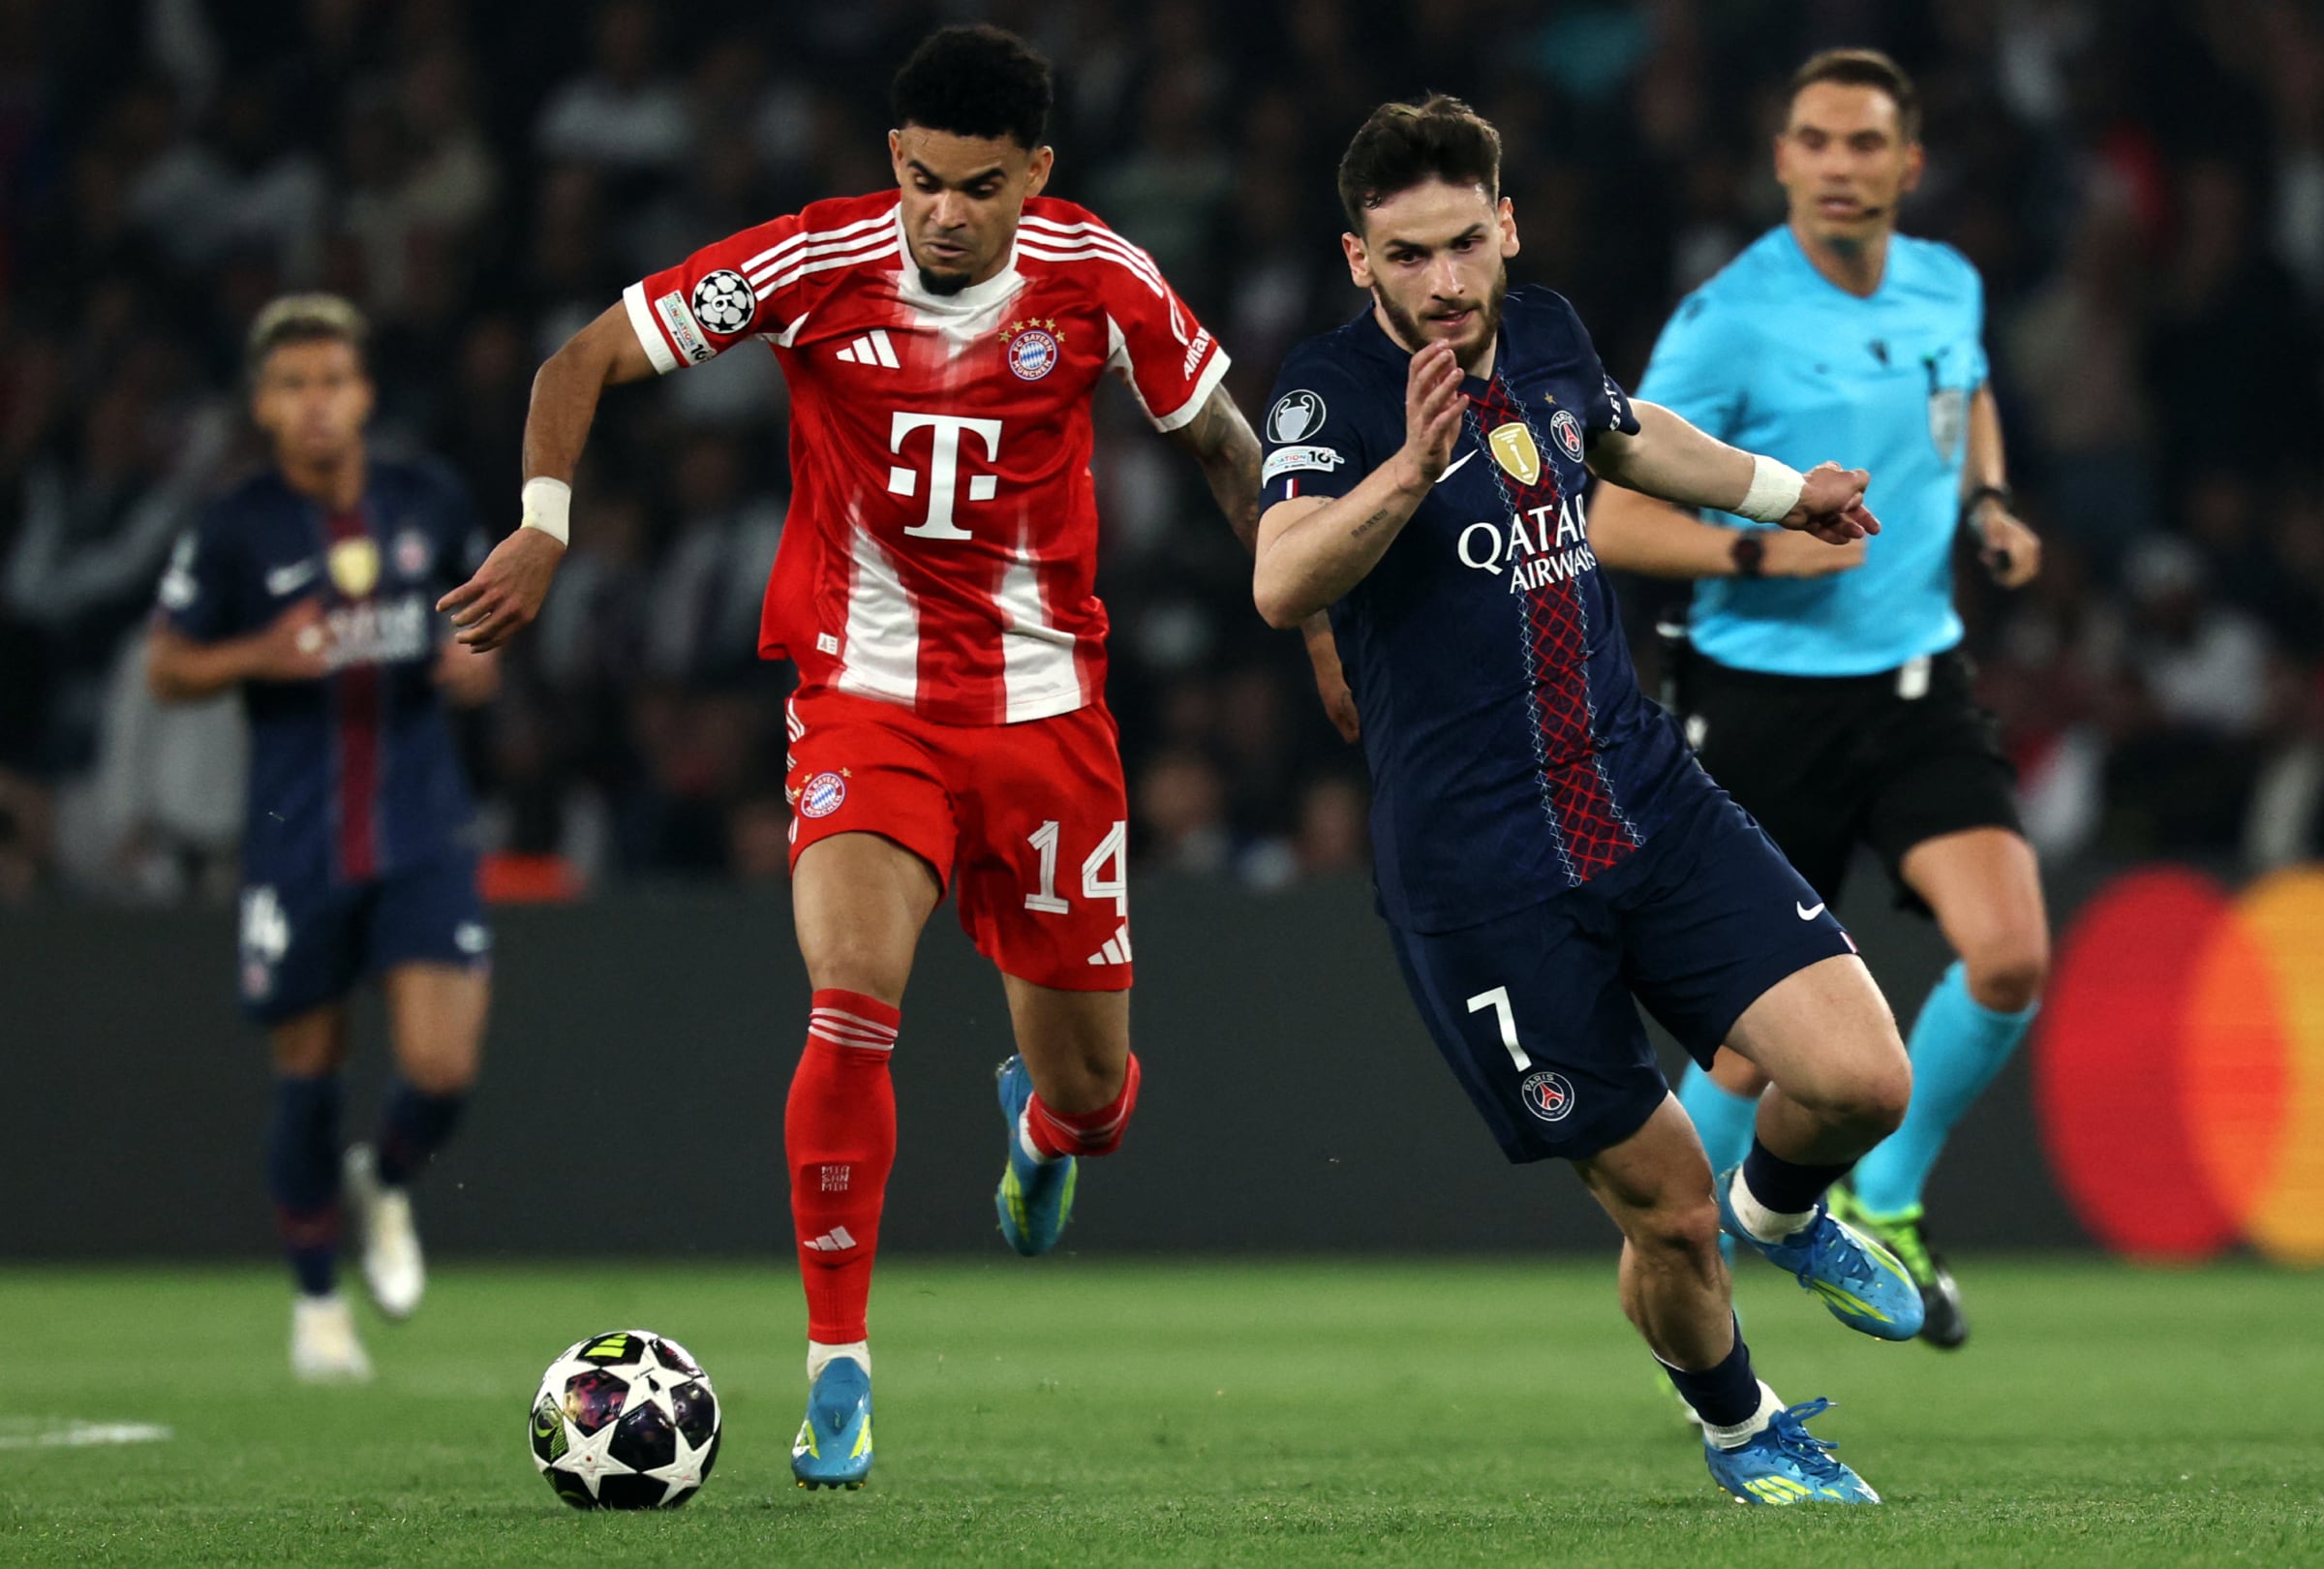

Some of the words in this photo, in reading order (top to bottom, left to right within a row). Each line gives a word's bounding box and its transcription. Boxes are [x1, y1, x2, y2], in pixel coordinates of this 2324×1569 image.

[1013, 340, 1024, 353] FC
[1023, 333, 1054, 352] BAYERN
[888, 412, 1002, 540] T
[1510, 542, 1596, 594] AIRWAYS
[1024, 820, 1126, 917] 14
[1466, 985, 1532, 1072] 7
[1524, 1073, 1554, 1092] PARIS
